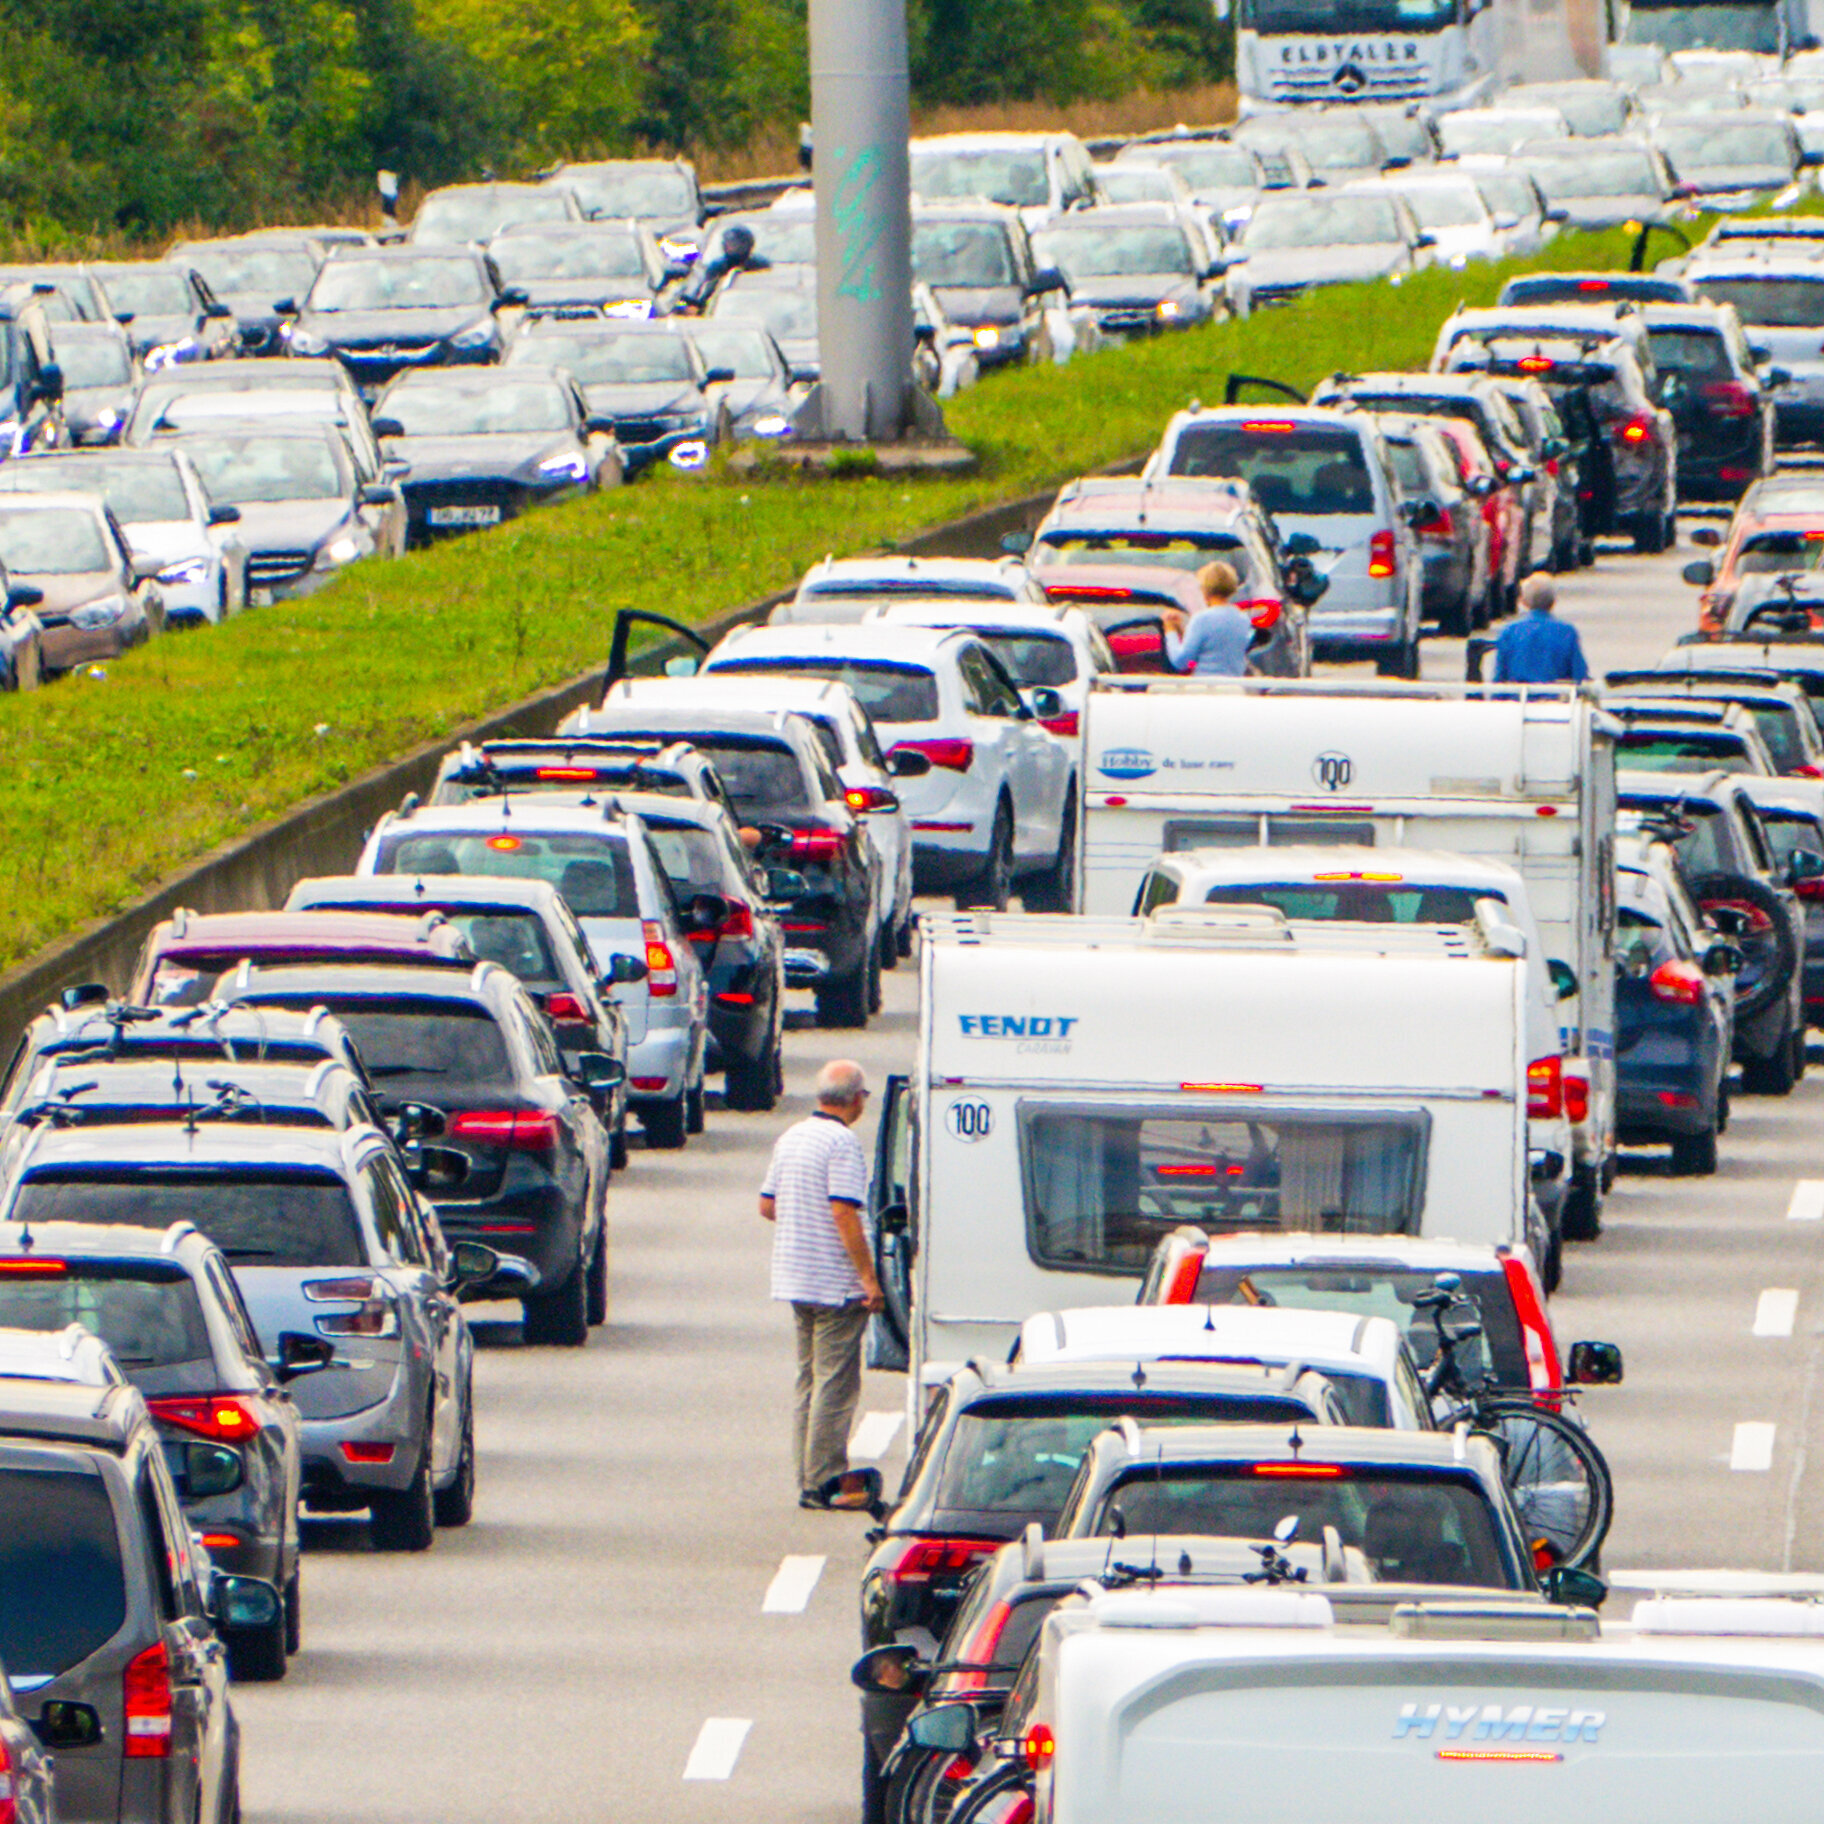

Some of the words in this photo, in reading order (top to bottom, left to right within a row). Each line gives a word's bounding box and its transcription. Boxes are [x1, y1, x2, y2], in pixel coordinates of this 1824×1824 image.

[1101, 753, 1152, 769] Hobby
[958, 1015, 1079, 1038] FENDT
[952, 1103, 990, 1135] 100
[1392, 1703, 1606, 1743] HYMER
